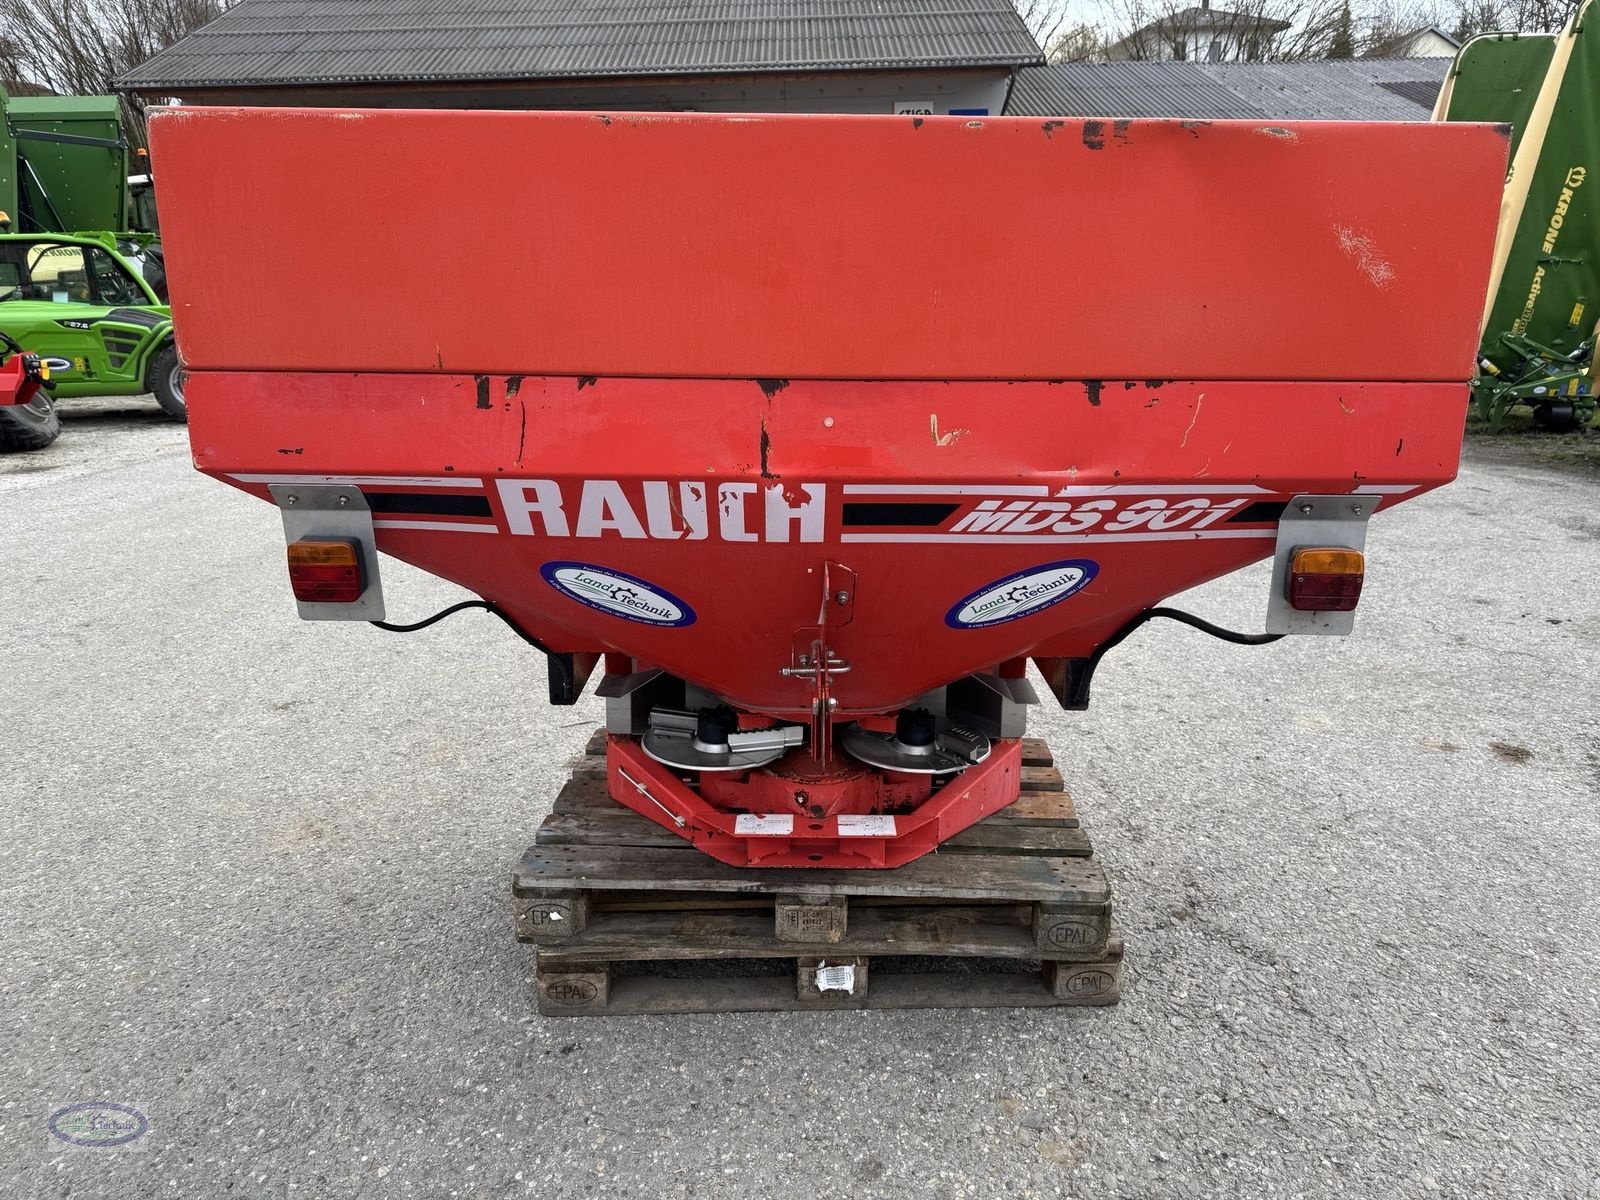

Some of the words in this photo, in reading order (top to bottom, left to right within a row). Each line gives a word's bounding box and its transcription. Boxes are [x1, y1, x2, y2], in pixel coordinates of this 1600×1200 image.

[1542, 188, 1573, 254] KRONE
[50, 248, 82, 257] KRON
[495, 478, 826, 543] RAUCH
[949, 499, 1117, 532] MDS
[1104, 498, 1249, 532] 901
[574, 572, 614, 592] Land
[1019, 573, 1077, 600] Technik
[620, 594, 673, 619] Technik
[970, 594, 1007, 614] Land
[1055, 927, 1092, 945] EPAL
